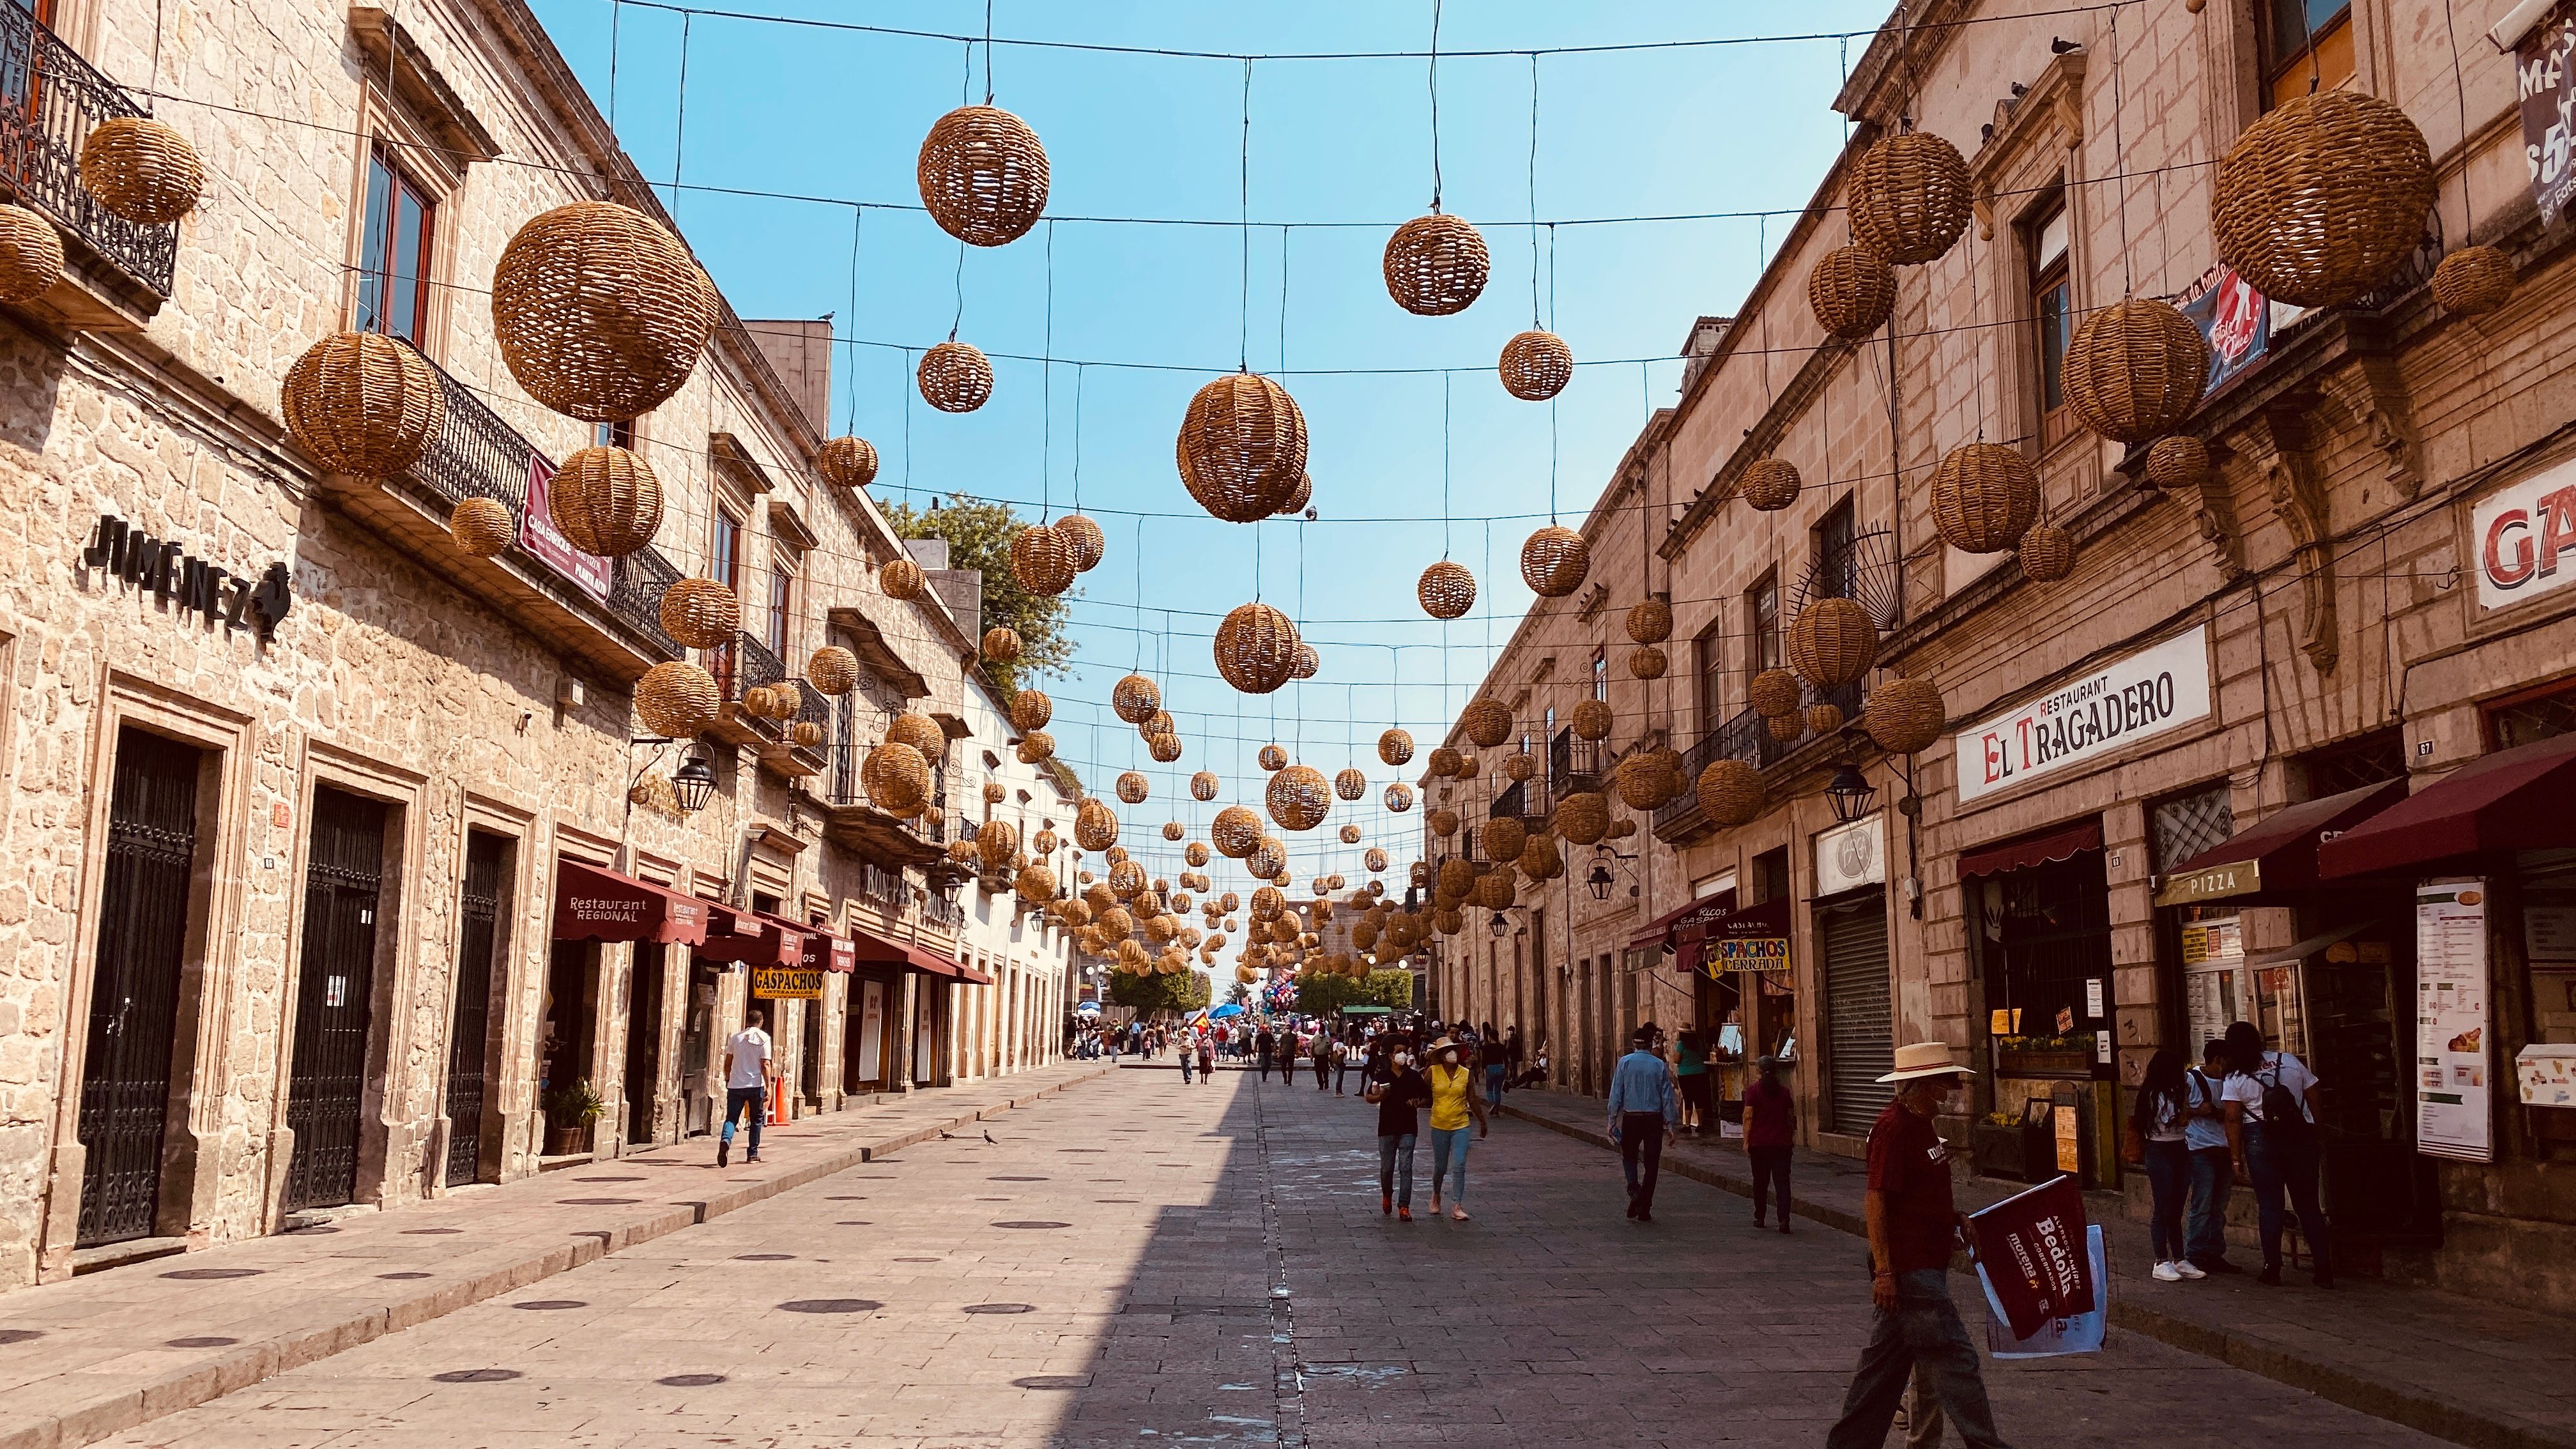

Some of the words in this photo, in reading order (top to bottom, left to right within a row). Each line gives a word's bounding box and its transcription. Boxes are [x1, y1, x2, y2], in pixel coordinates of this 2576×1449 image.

[528, 514, 546, 538] CASA
[545, 527, 572, 556] ENRIQUE
[593, 577, 607, 597] ALTA
[2041, 675, 2108, 717] RESTAURANT
[2015, 671, 2174, 771] TRAGADERO
[2190, 871, 2236, 894] PIZZA
[570, 897, 647, 911] Restaurant
[577, 910, 638, 923] REGIONAL
[1707, 940, 1786, 963] GASPACHOS
[1725, 958, 1785, 971] CERRADA
[755, 971, 822, 990] GASPACHOS
[2052, 1216, 2070, 1253] ALFREDO
[2009, 1232, 2037, 1278] morena
[2034, 1243, 2057, 1291] GOBERNADOR
[2035, 1217, 2071, 1298] Bedolla
